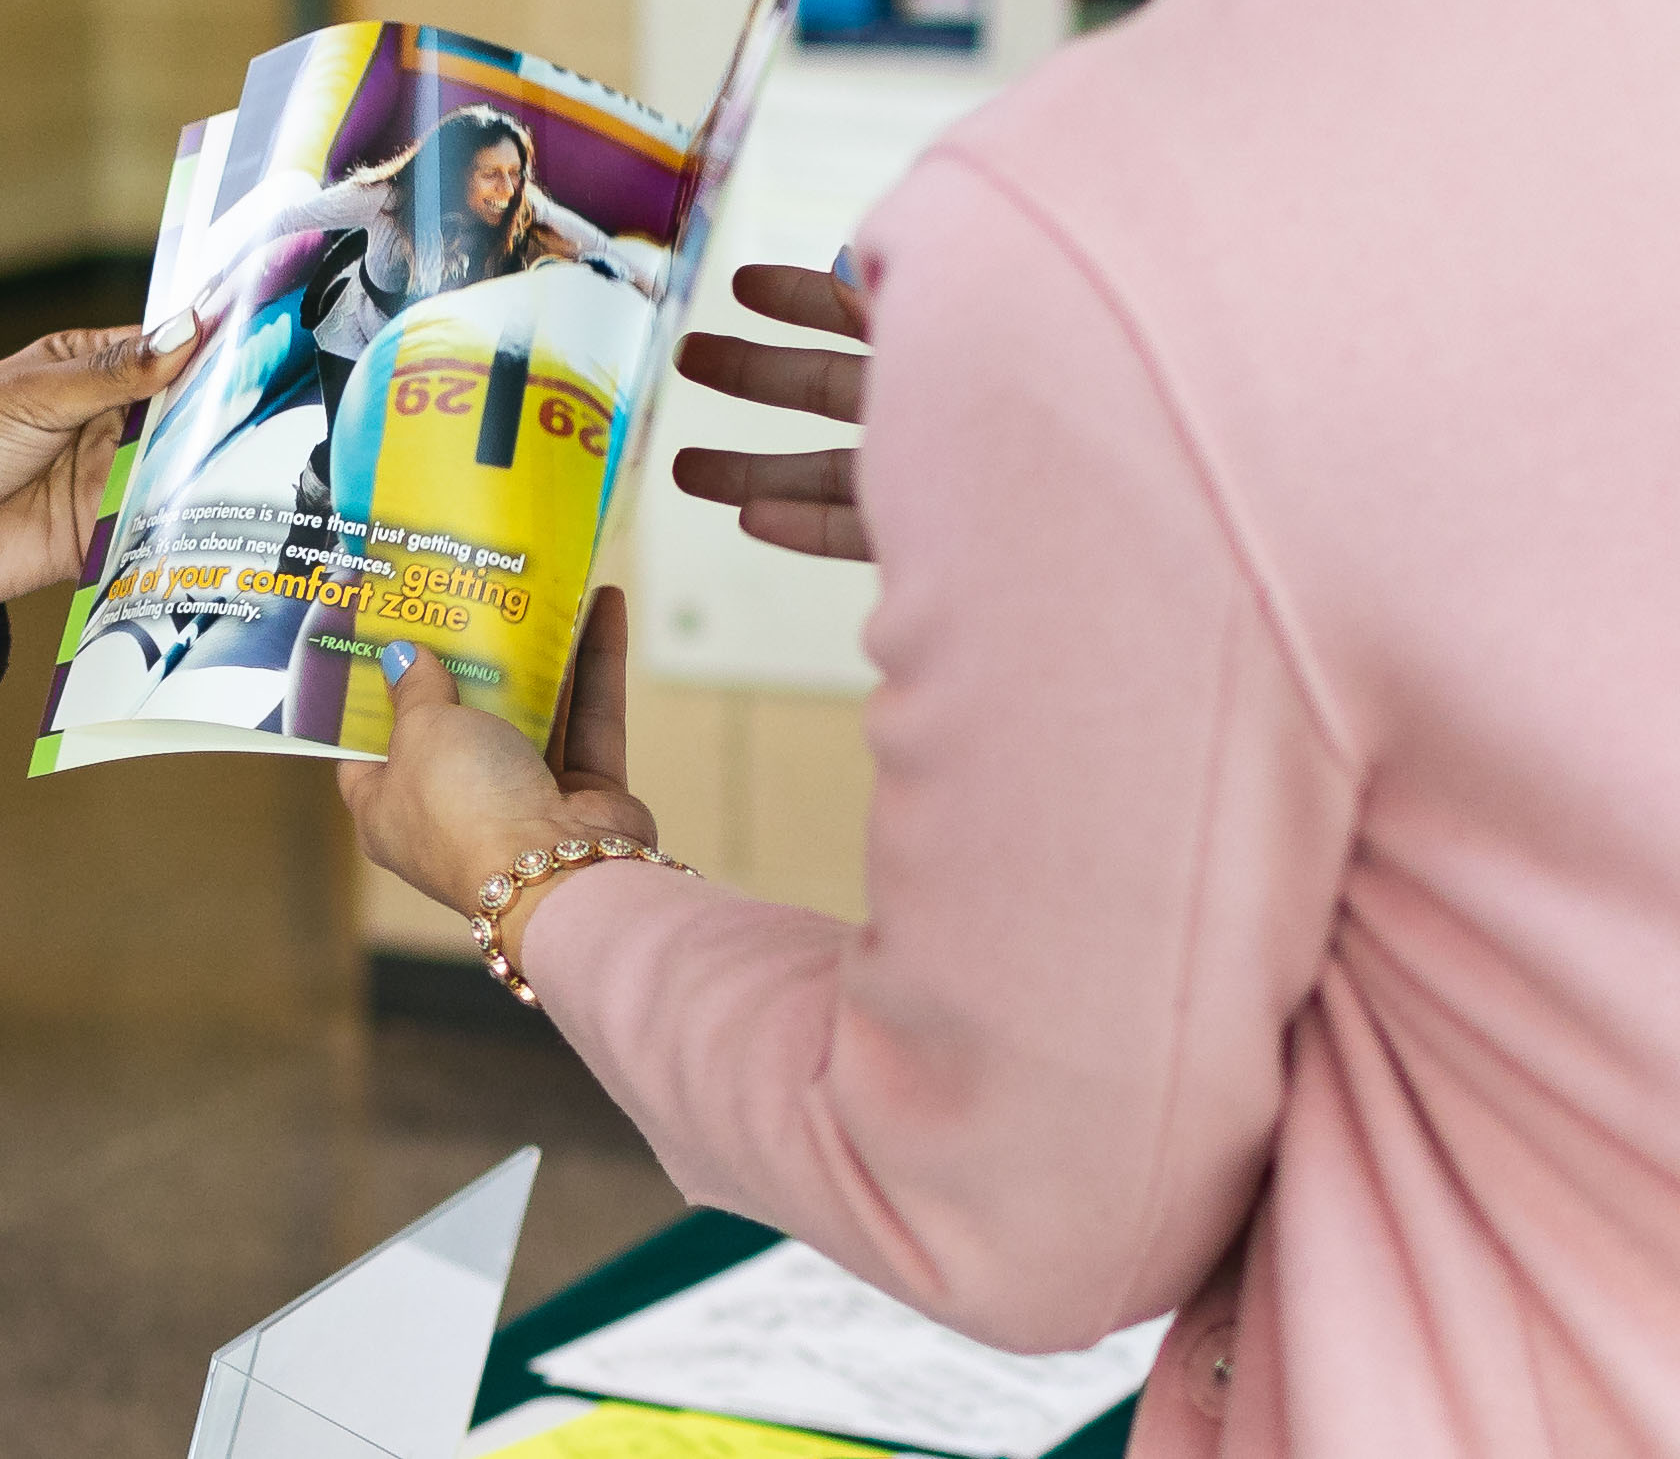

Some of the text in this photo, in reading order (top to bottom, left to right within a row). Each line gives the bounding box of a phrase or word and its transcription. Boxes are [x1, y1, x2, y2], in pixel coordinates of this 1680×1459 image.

[181, 502, 256, 525] experience
[258, 503, 273, 522] is
[276, 510, 323, 529] more
[326, 515, 368, 537] than
[370, 521, 406, 545] just
[406, 533, 472, 562] getting
[474, 547, 526, 574] good
[101, 598, 262, 625] and building a community.
[107, 554, 471, 632] out of your comfort zone
[120, 541, 154, 568] grades,
[172, 532, 198, 552] also
[199, 531, 244, 552] about
[244, 539, 283, 555] new
[285, 544, 397, 579] experiences,
[401, 564, 530, 624] getting
